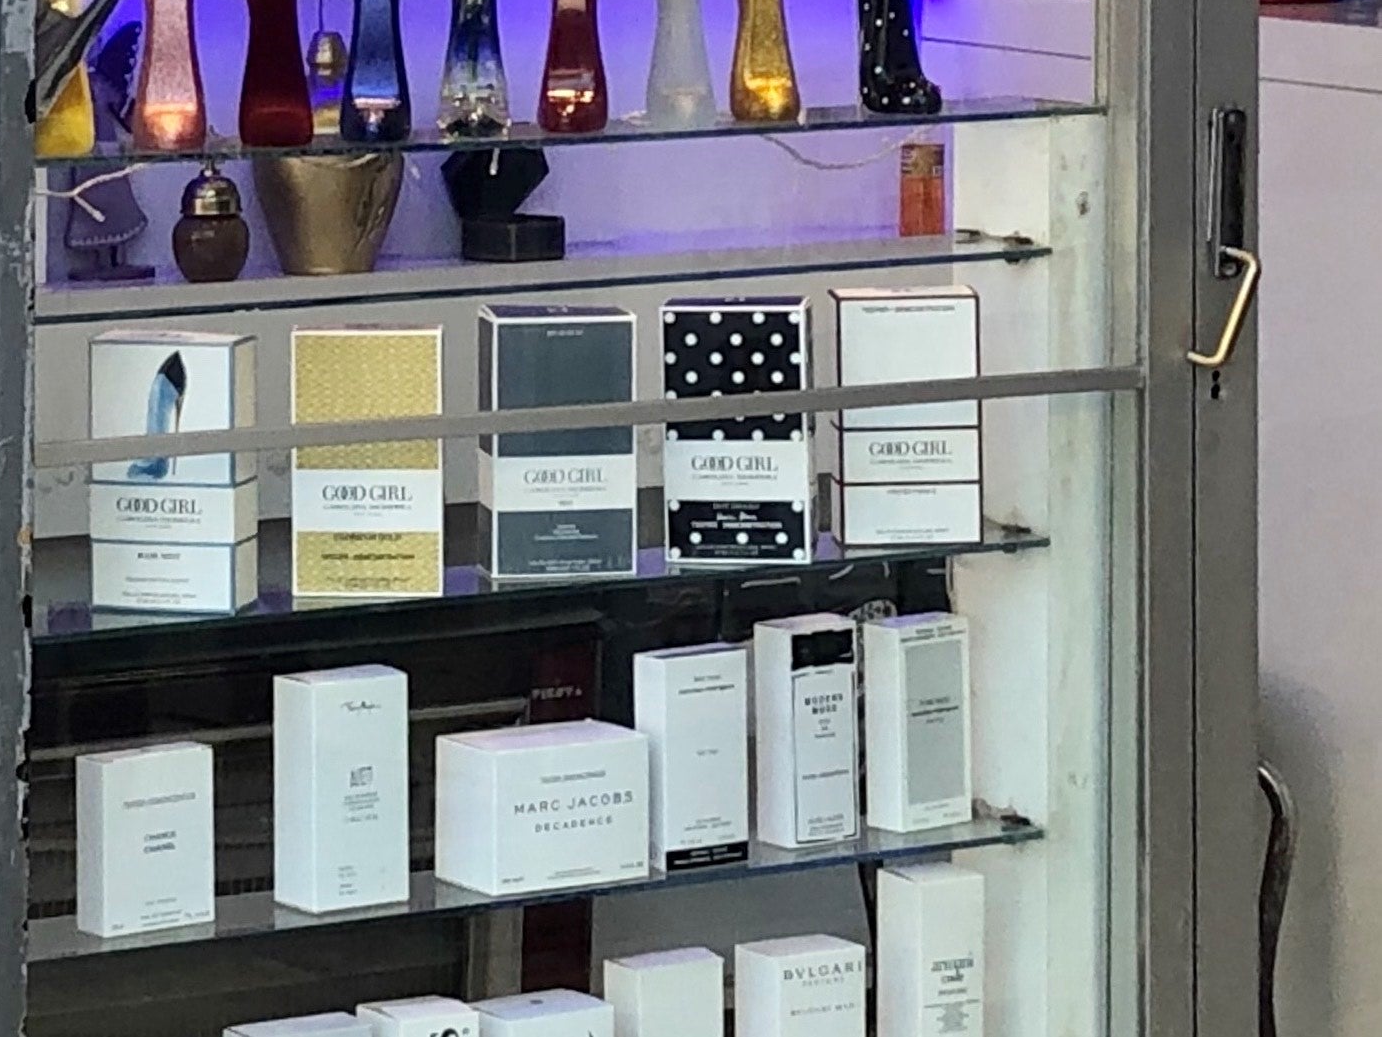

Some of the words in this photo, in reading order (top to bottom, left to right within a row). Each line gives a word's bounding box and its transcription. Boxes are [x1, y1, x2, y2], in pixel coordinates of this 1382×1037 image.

[322, 484, 367, 501] GOOD
[369, 484, 414, 501] GIRL
[116, 497, 158, 513] GOOD
[160, 498, 204, 515] GIRL
[514, 799, 561, 814] MARC
[567, 790, 633, 810] JACOBS
[534, 815, 614, 833] DECADENCE
[783, 960, 863, 981] BVLGARI
